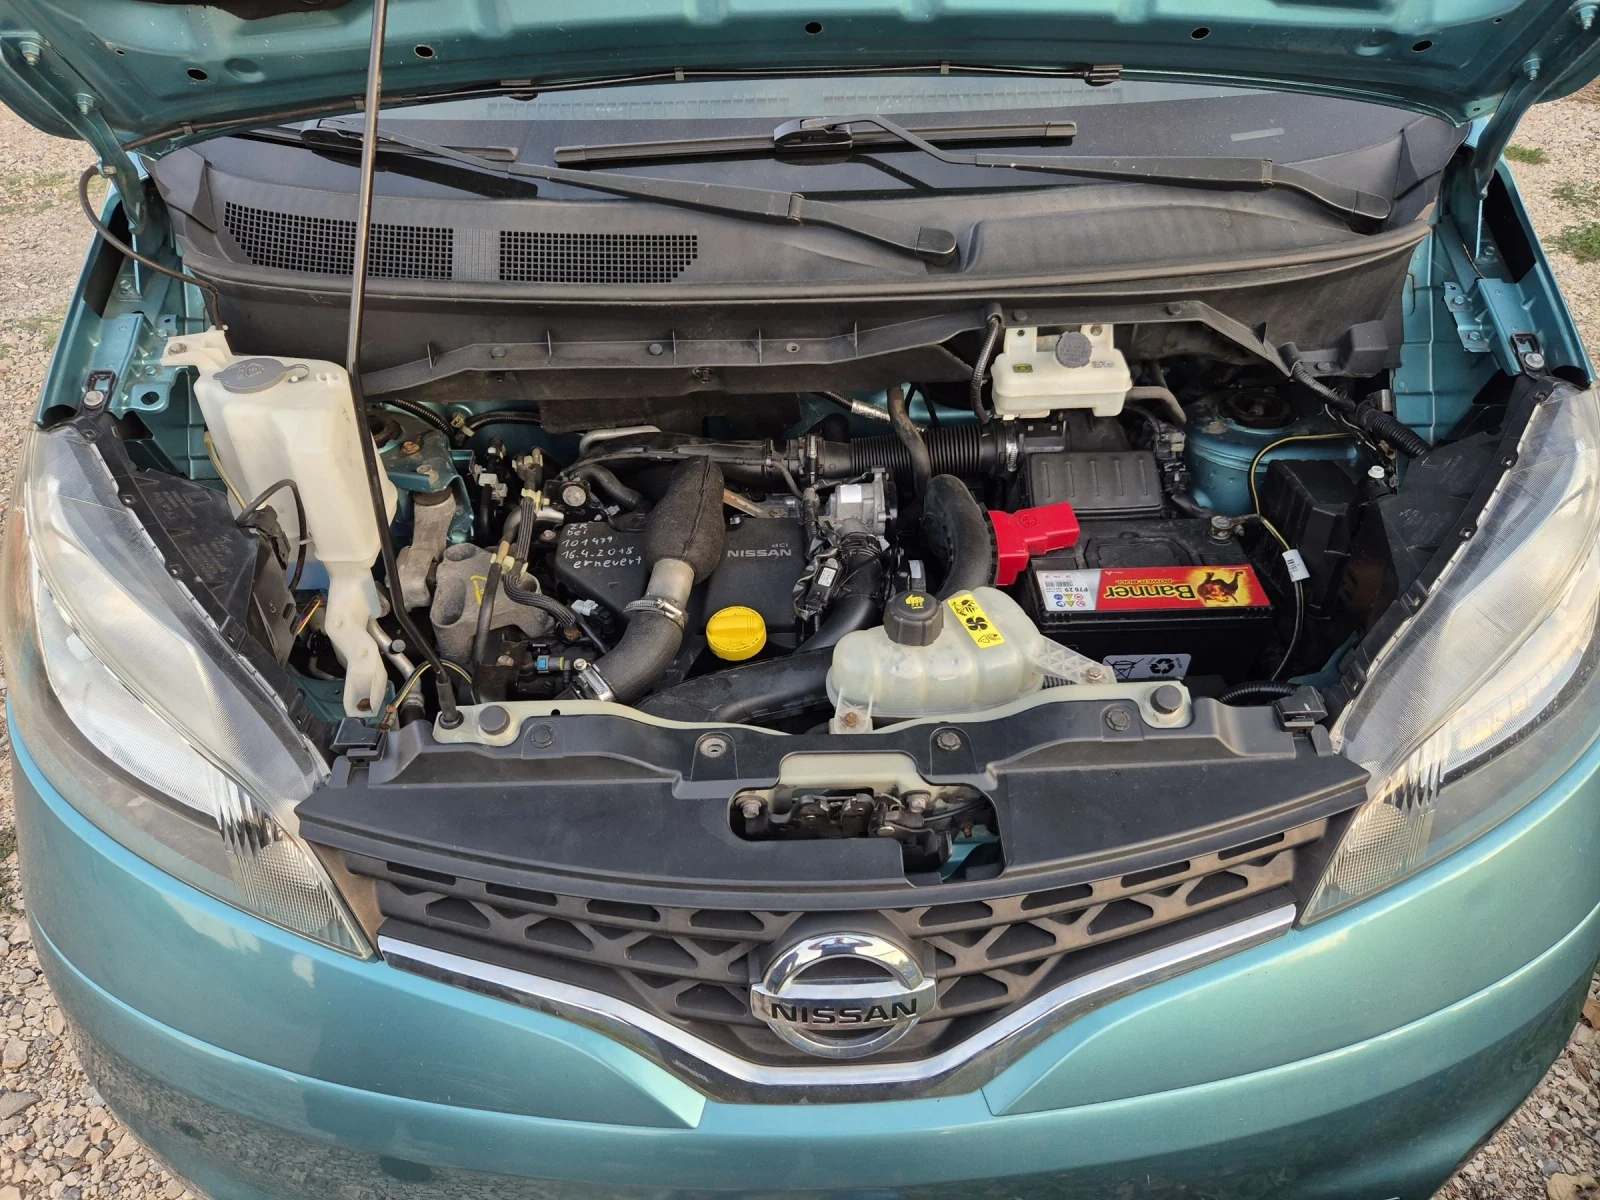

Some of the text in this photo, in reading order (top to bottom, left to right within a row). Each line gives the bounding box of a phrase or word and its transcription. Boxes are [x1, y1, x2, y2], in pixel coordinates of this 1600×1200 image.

[727, 549, 792, 558] NISSAN
[1104, 583, 1197, 600] Banner
[770, 998, 917, 1024] NISSAN
